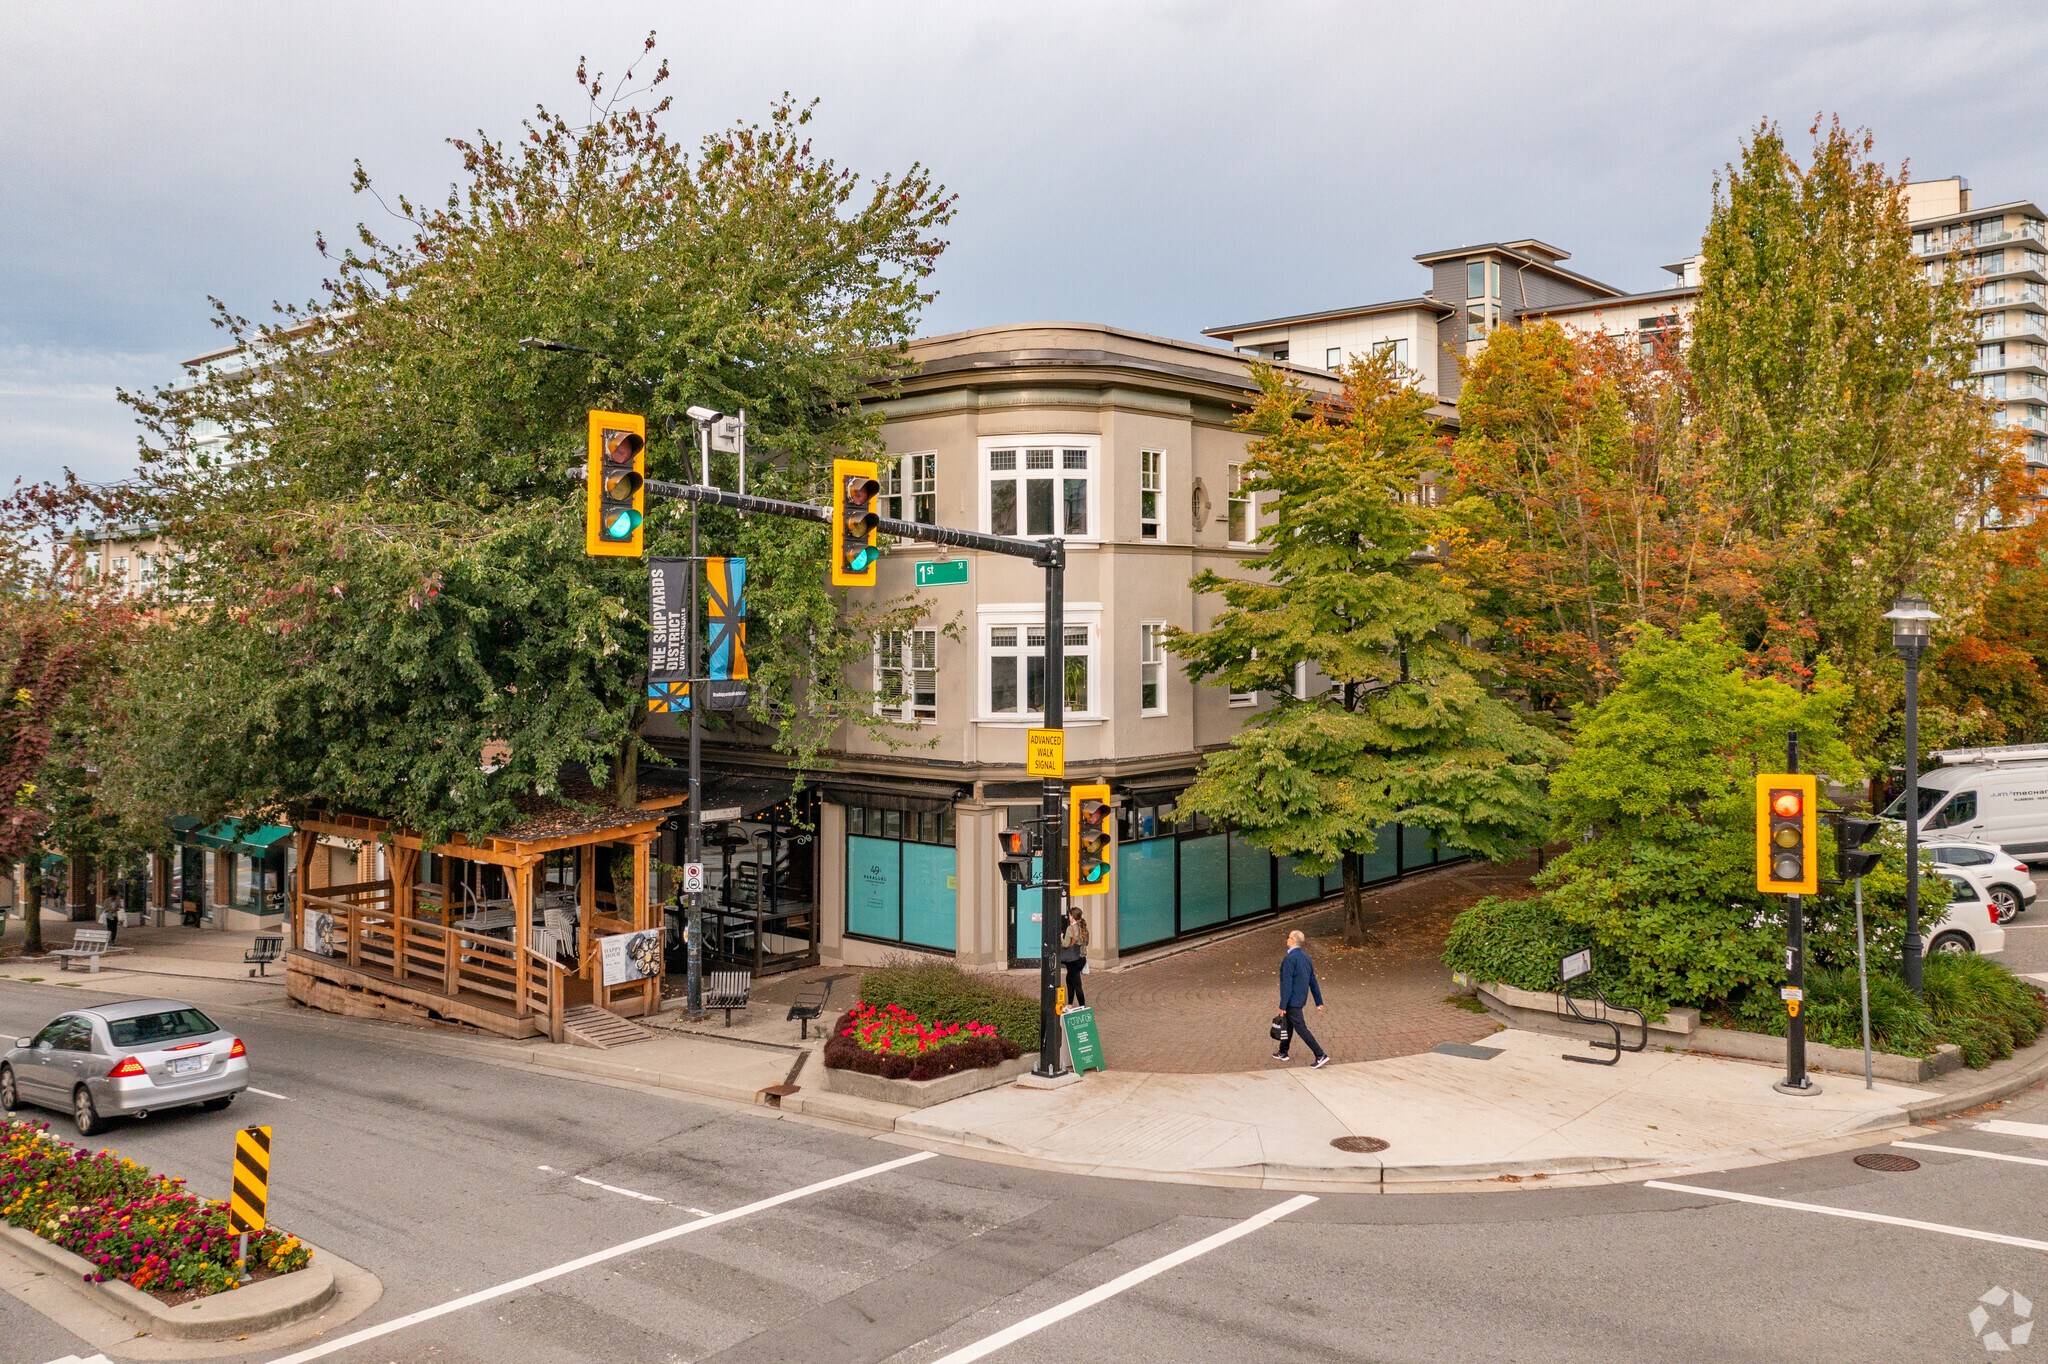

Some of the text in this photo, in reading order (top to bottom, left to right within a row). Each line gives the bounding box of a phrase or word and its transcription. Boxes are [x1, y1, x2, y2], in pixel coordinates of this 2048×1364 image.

[919, 565, 934, 583] 1st
[651, 568, 667, 671] THE SHIPYARDS
[666, 611, 680, 670] DISTRICT
[1031, 735, 1061, 745] ADVANCED
[1037, 748, 1054, 757] WALK
[1035, 760, 1056, 770] SIGNAL
[604, 946, 621, 954] HAPPY
